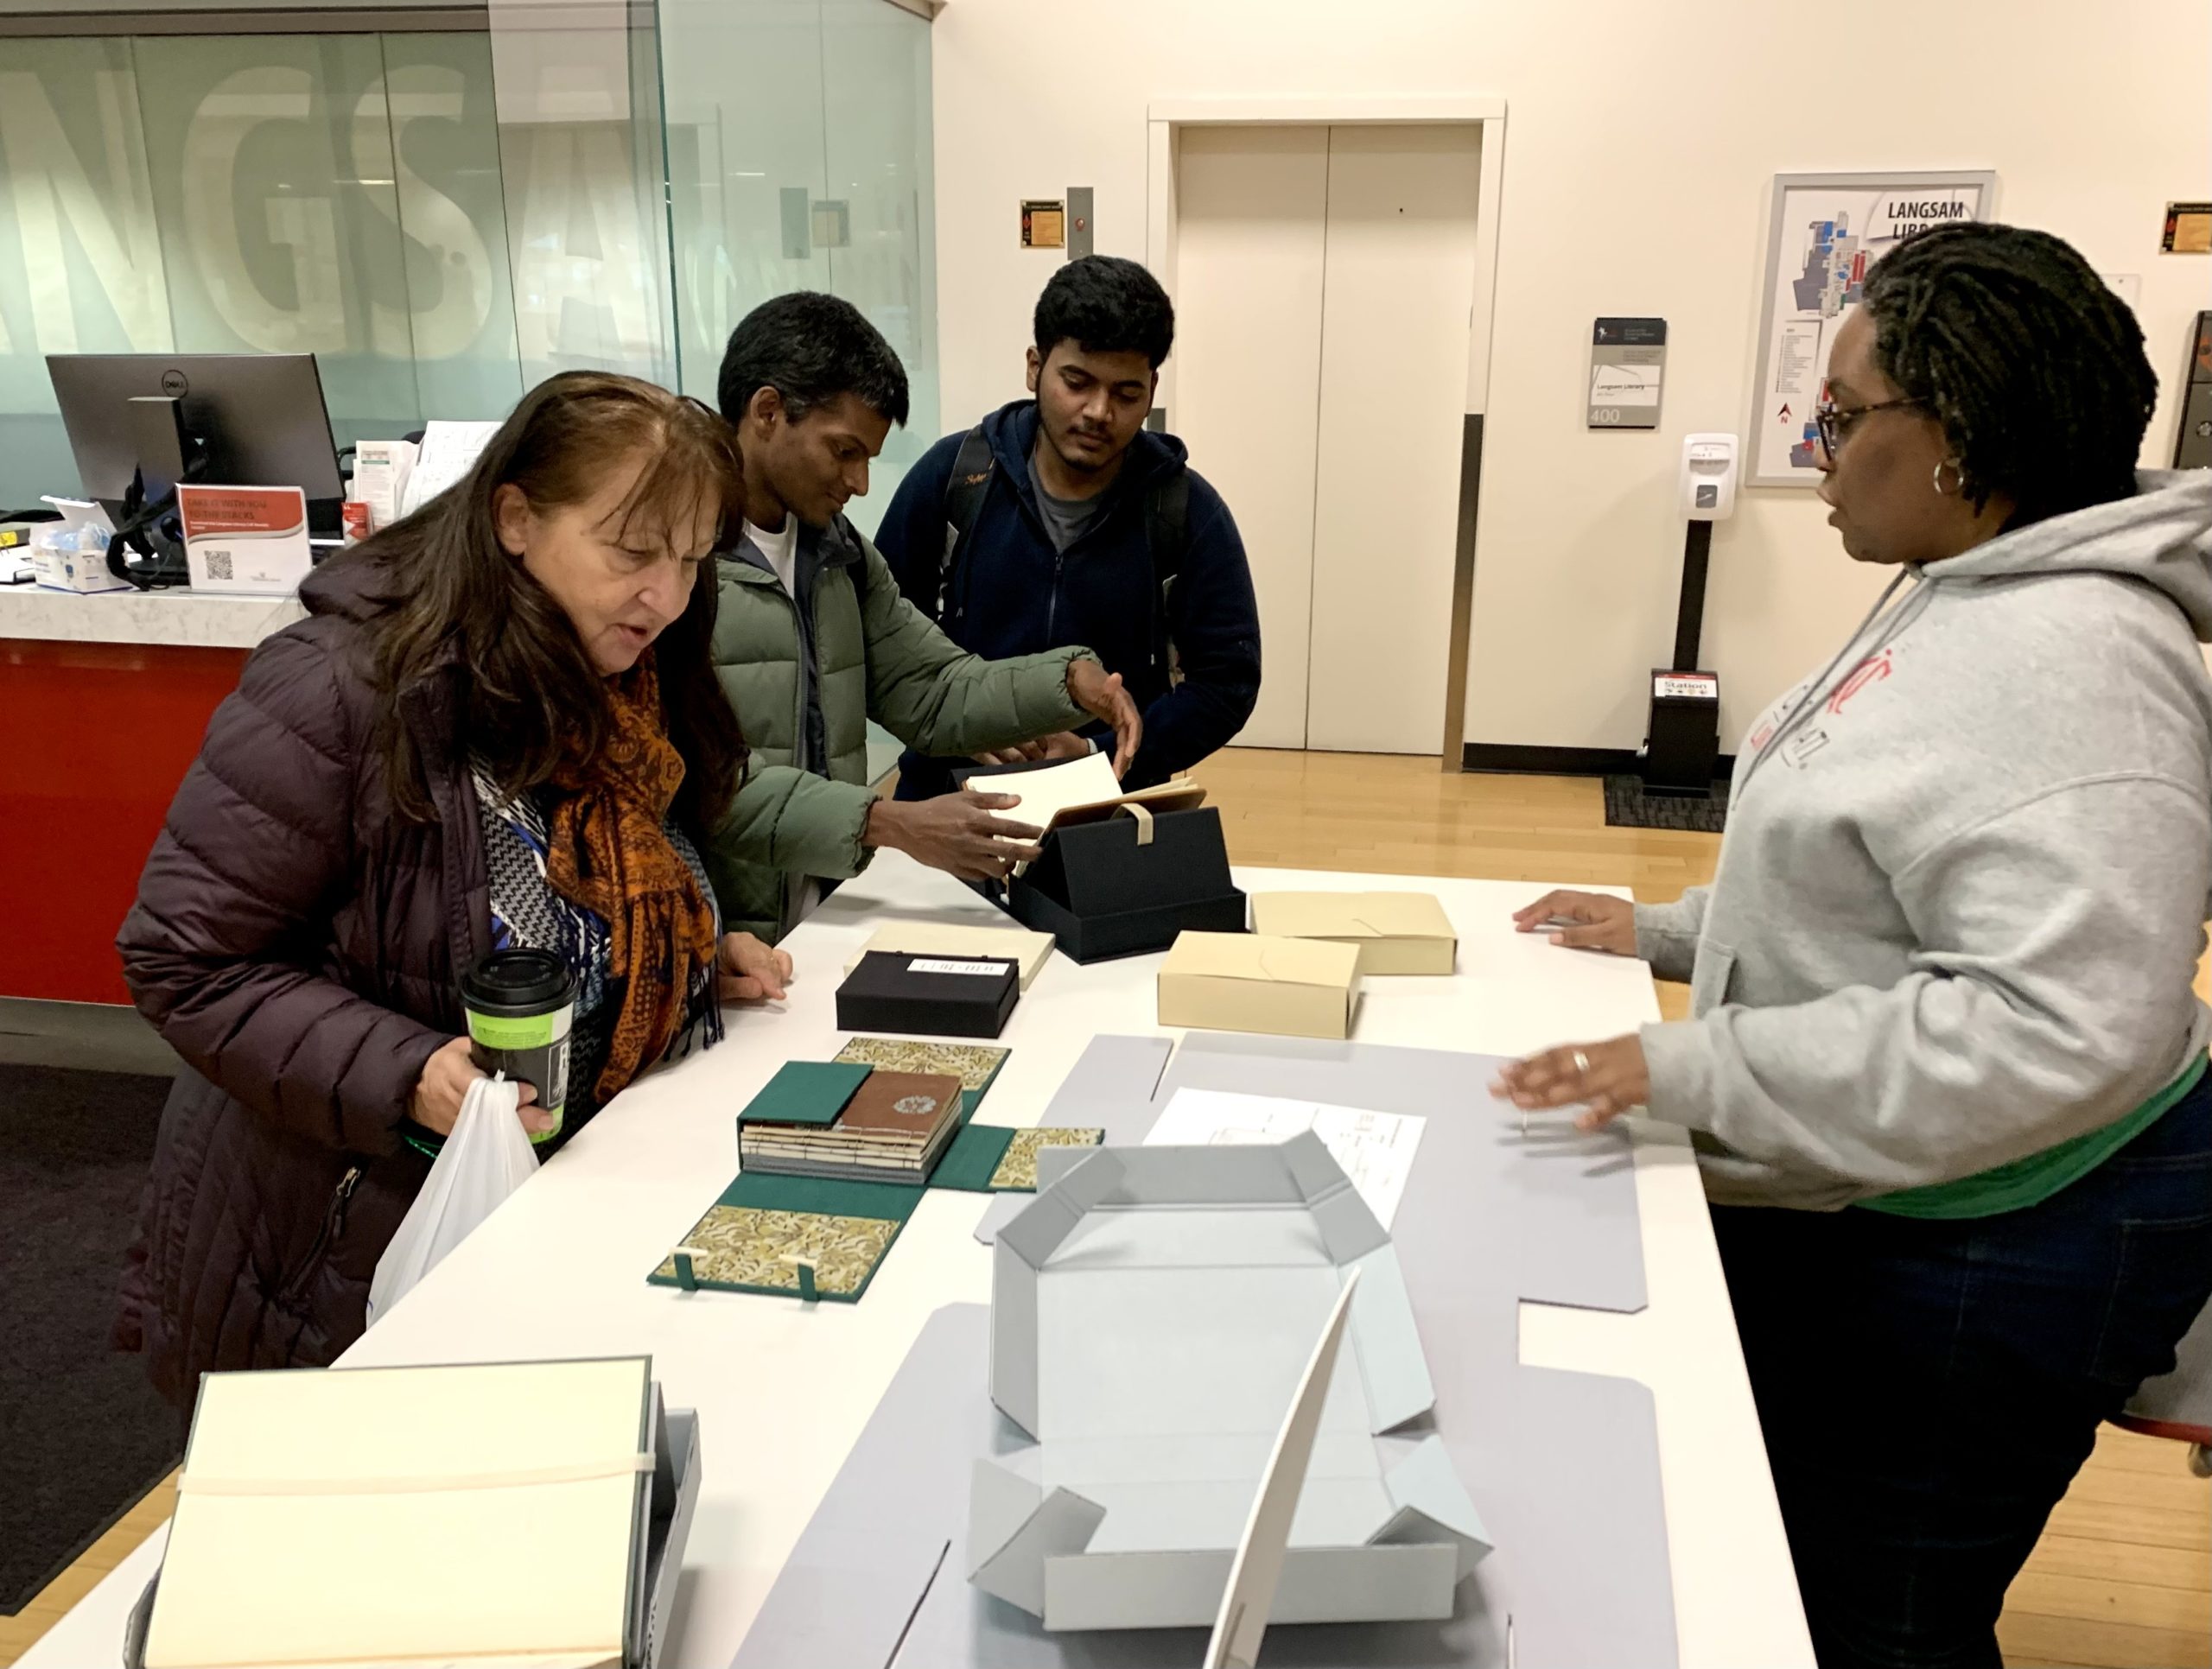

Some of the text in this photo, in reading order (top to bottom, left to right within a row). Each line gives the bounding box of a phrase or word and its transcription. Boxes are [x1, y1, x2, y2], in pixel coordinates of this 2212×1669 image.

[0, 64, 667, 360] NGSA
[1887, 200, 1964, 219] LANGSAM
[1591, 409, 1620, 423] 400
[1664, 681, 1707, 689] Station
